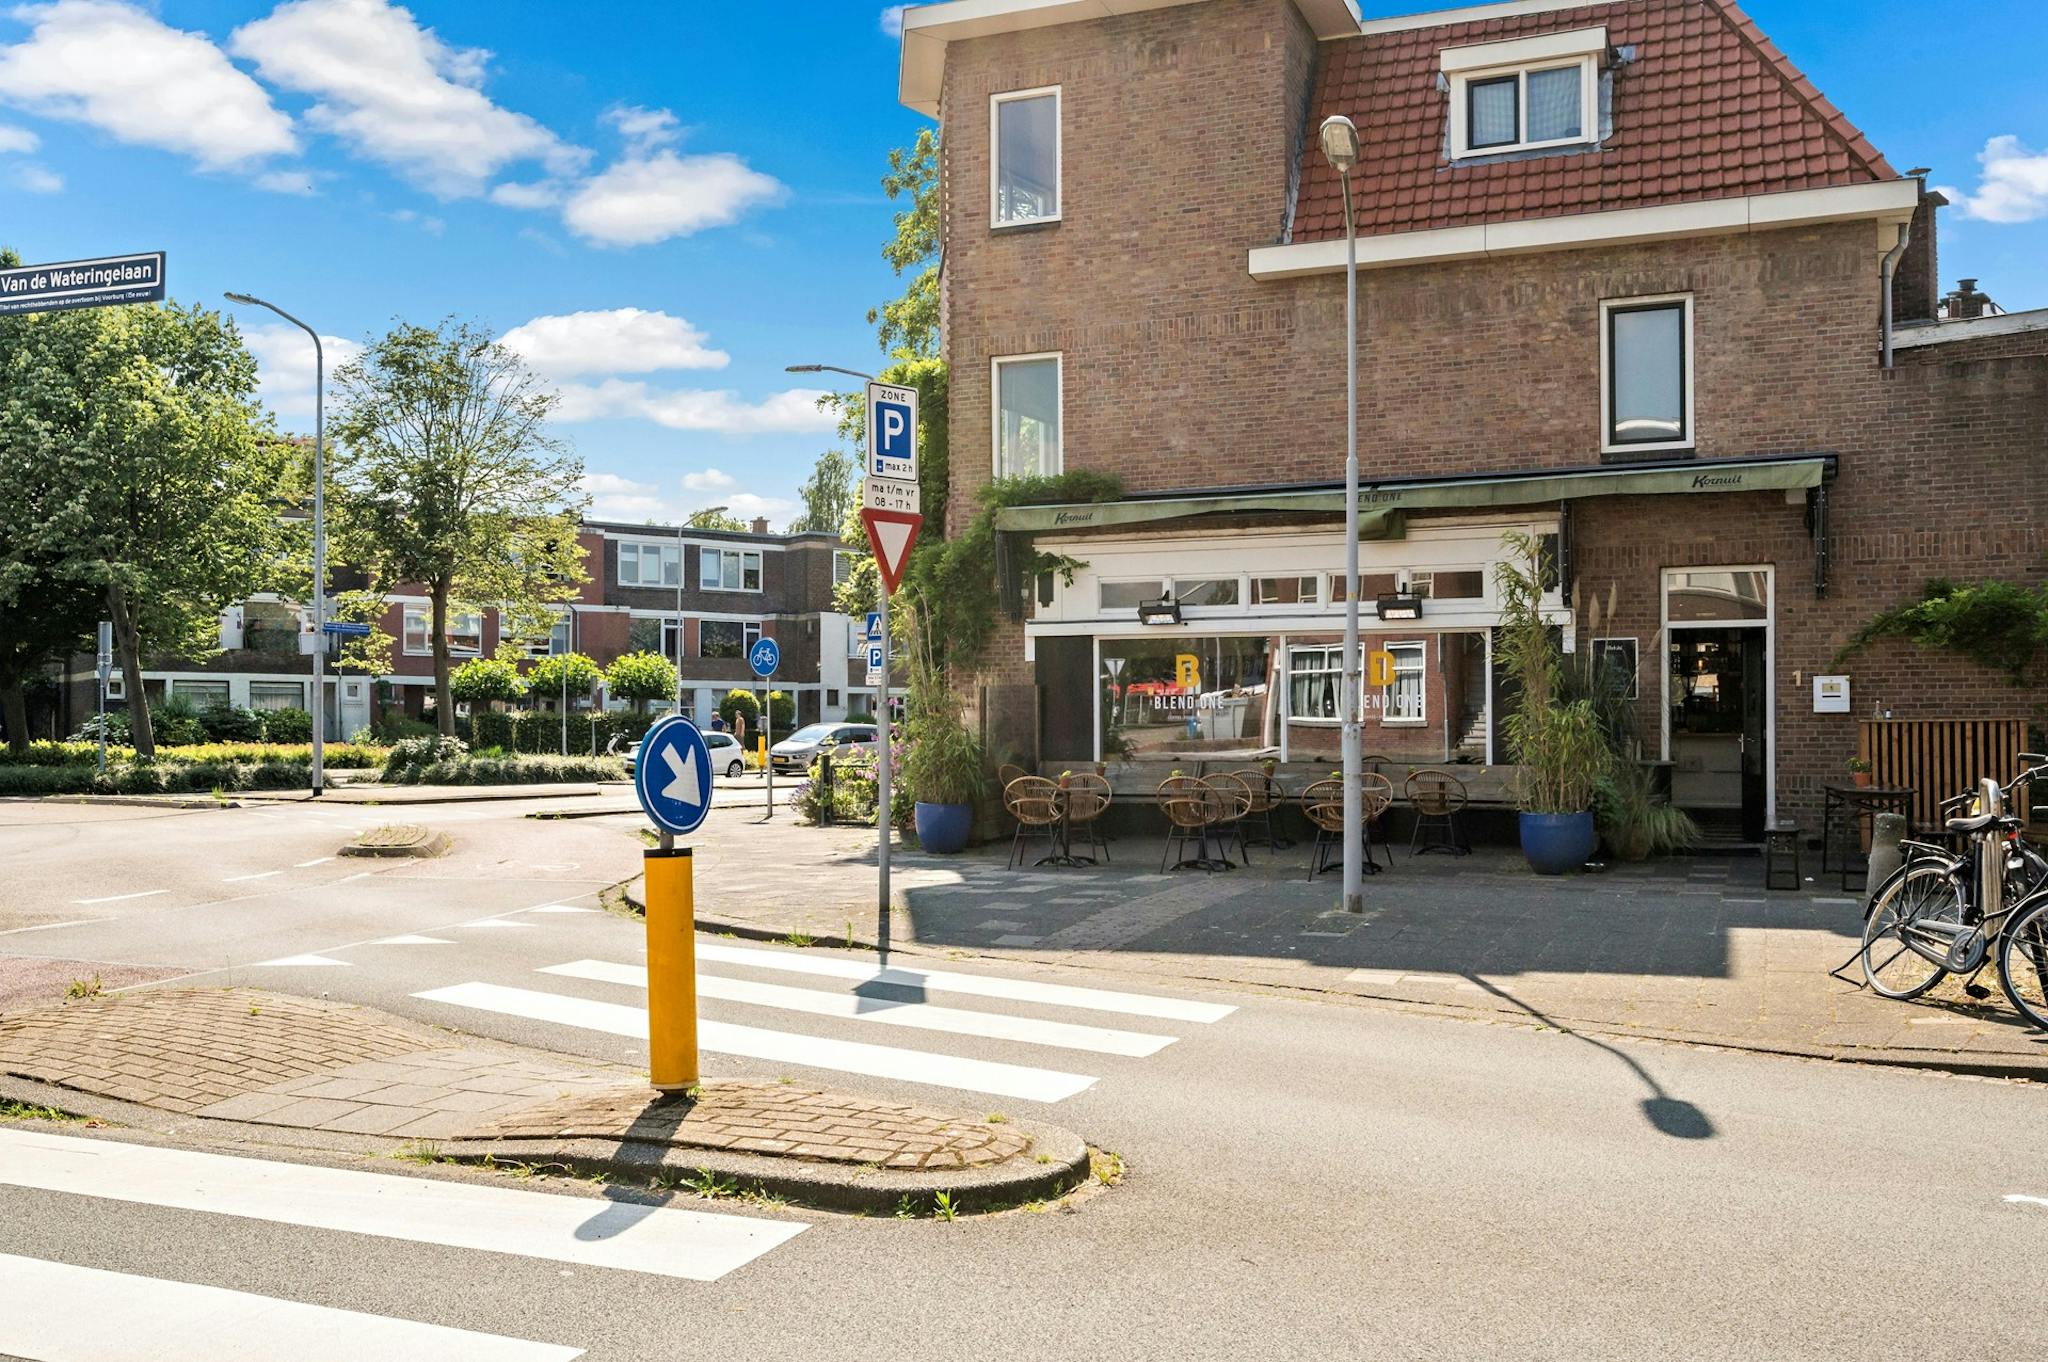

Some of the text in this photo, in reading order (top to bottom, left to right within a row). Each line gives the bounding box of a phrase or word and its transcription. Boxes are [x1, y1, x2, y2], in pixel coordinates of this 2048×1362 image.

[1, 264, 152, 293] Van de Wateringelaan
[881, 390, 906, 402] ZONE
[884, 408, 904, 450] P
[885, 463, 913, 473] max 2 h
[872, 484, 914, 497] ma t/m vr
[875, 496, 886, 507] 08
[896, 499, 903, 508] 17
[906, 501, 911, 510] h
[872, 650, 881, 666] P
[1176, 654, 1200, 688] B
[1369, 651, 1396, 687] B
[1792, 670, 1802, 687] 1
[1154, 695, 1224, 710] BLEND ONE
[1396, 694, 1422, 709] ONE
